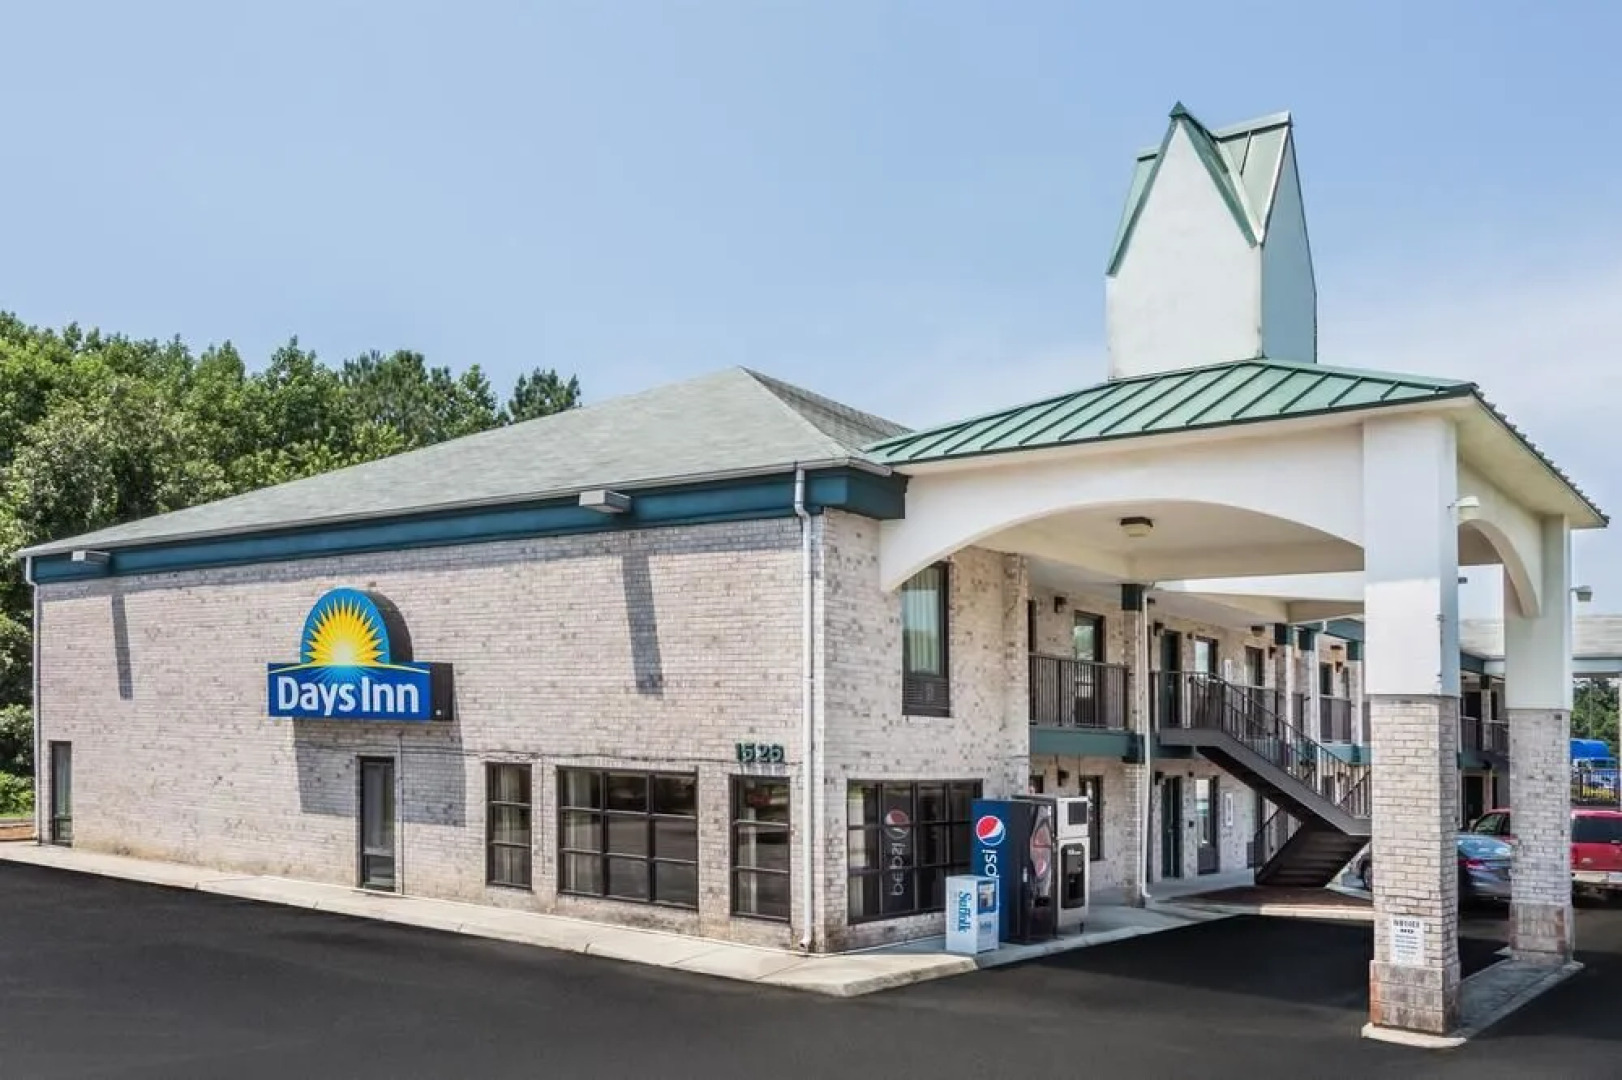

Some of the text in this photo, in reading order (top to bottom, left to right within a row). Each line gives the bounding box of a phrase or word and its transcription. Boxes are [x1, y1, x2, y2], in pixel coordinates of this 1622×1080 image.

[277, 676, 418, 716] Days Inn
[982, 849, 999, 878] psi
